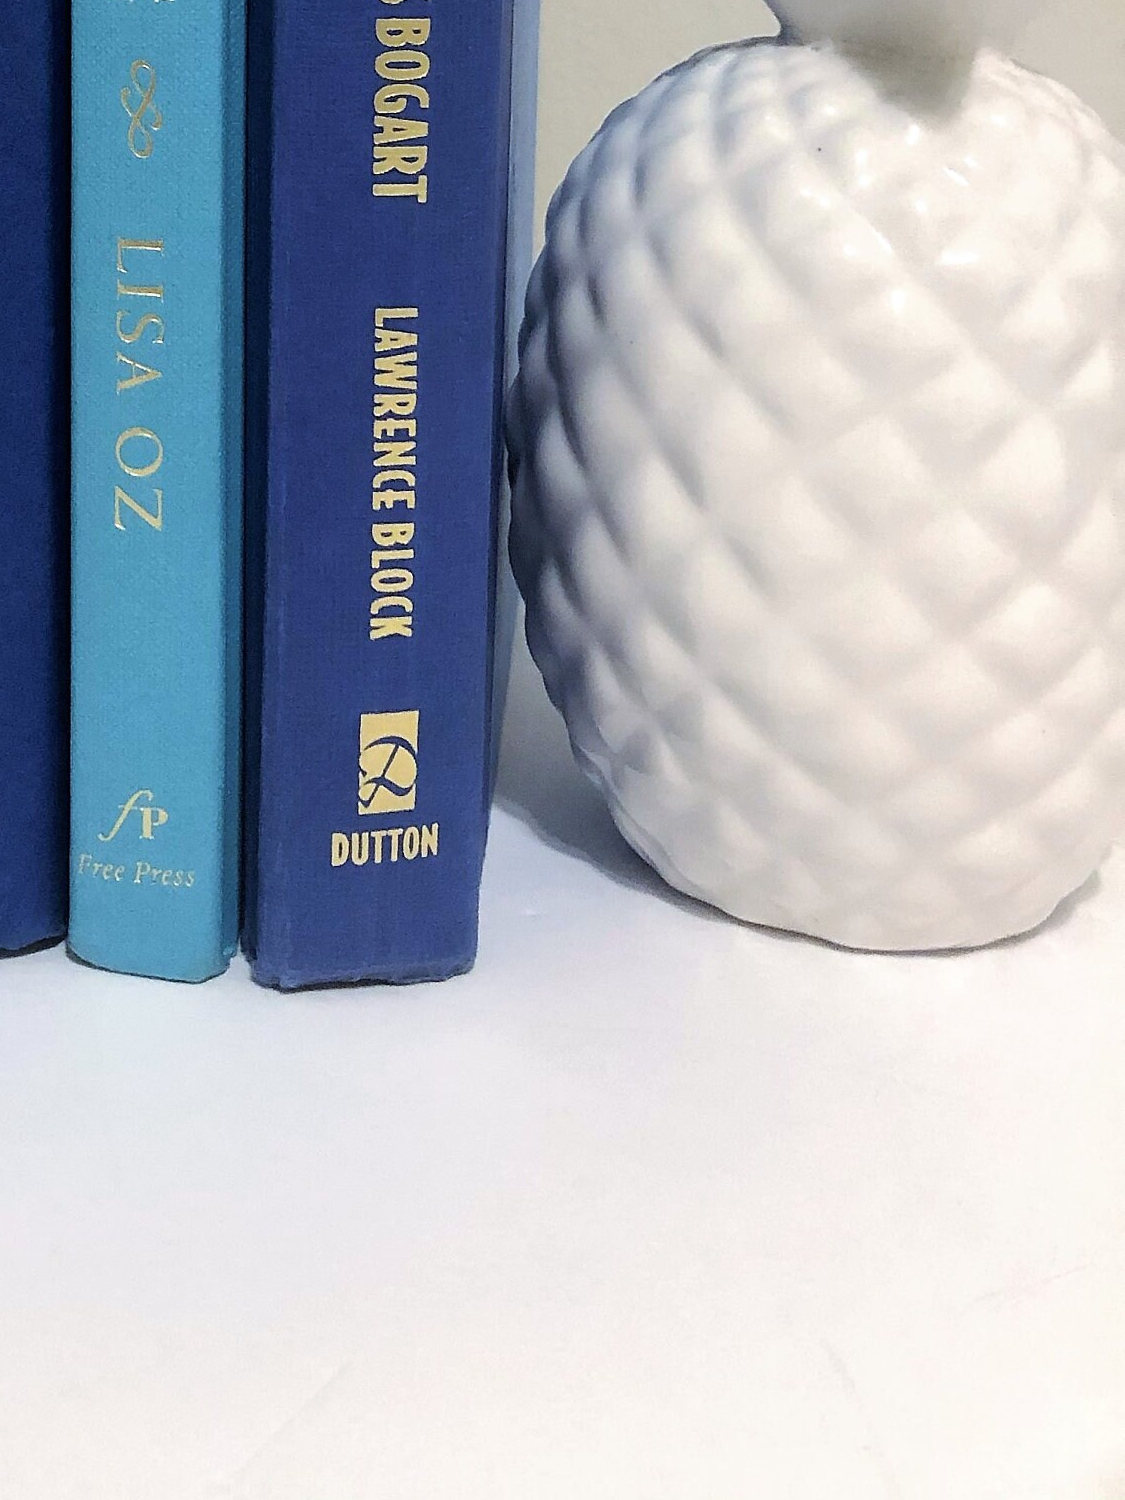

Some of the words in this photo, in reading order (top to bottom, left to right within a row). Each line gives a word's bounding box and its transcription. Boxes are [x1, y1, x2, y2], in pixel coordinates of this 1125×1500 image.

[372, 17, 431, 203] BOGART
[116, 237, 164, 391] LISA
[372, 306, 419, 510] LAWRENCE
[114, 426, 163, 530] OZ
[369, 522, 415, 640] BLOCK
[77, 852, 125, 883] Free
[132, 860, 197, 889] Press
[331, 823, 440, 868] DUTTON
